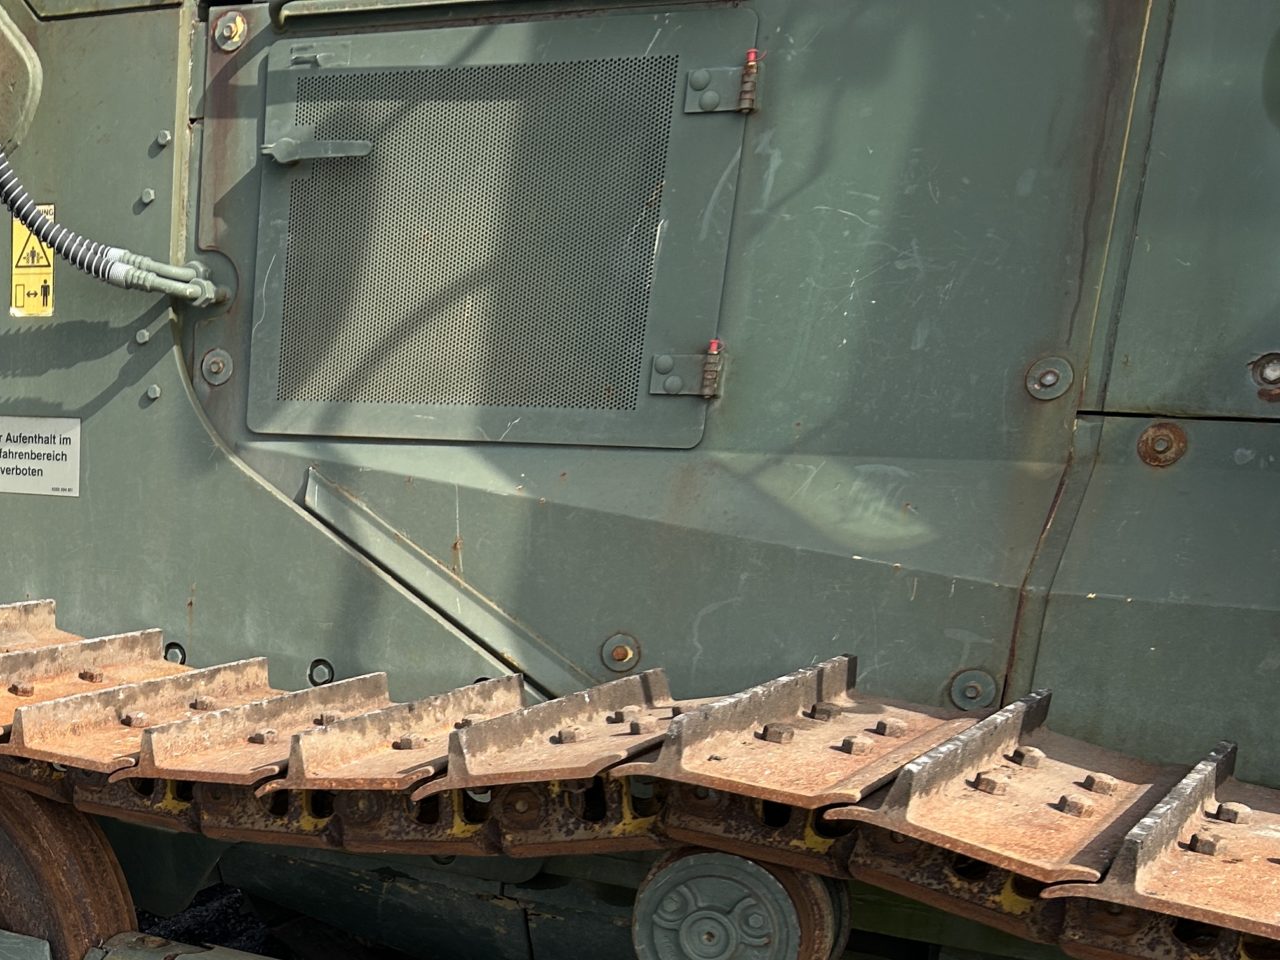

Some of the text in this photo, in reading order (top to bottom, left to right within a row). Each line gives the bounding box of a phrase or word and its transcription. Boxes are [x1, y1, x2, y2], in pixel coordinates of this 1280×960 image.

[5, 432, 56, 445] Aufenthalt
[59, 433, 72, 445] im
[0, 465, 44, 477] verboten
